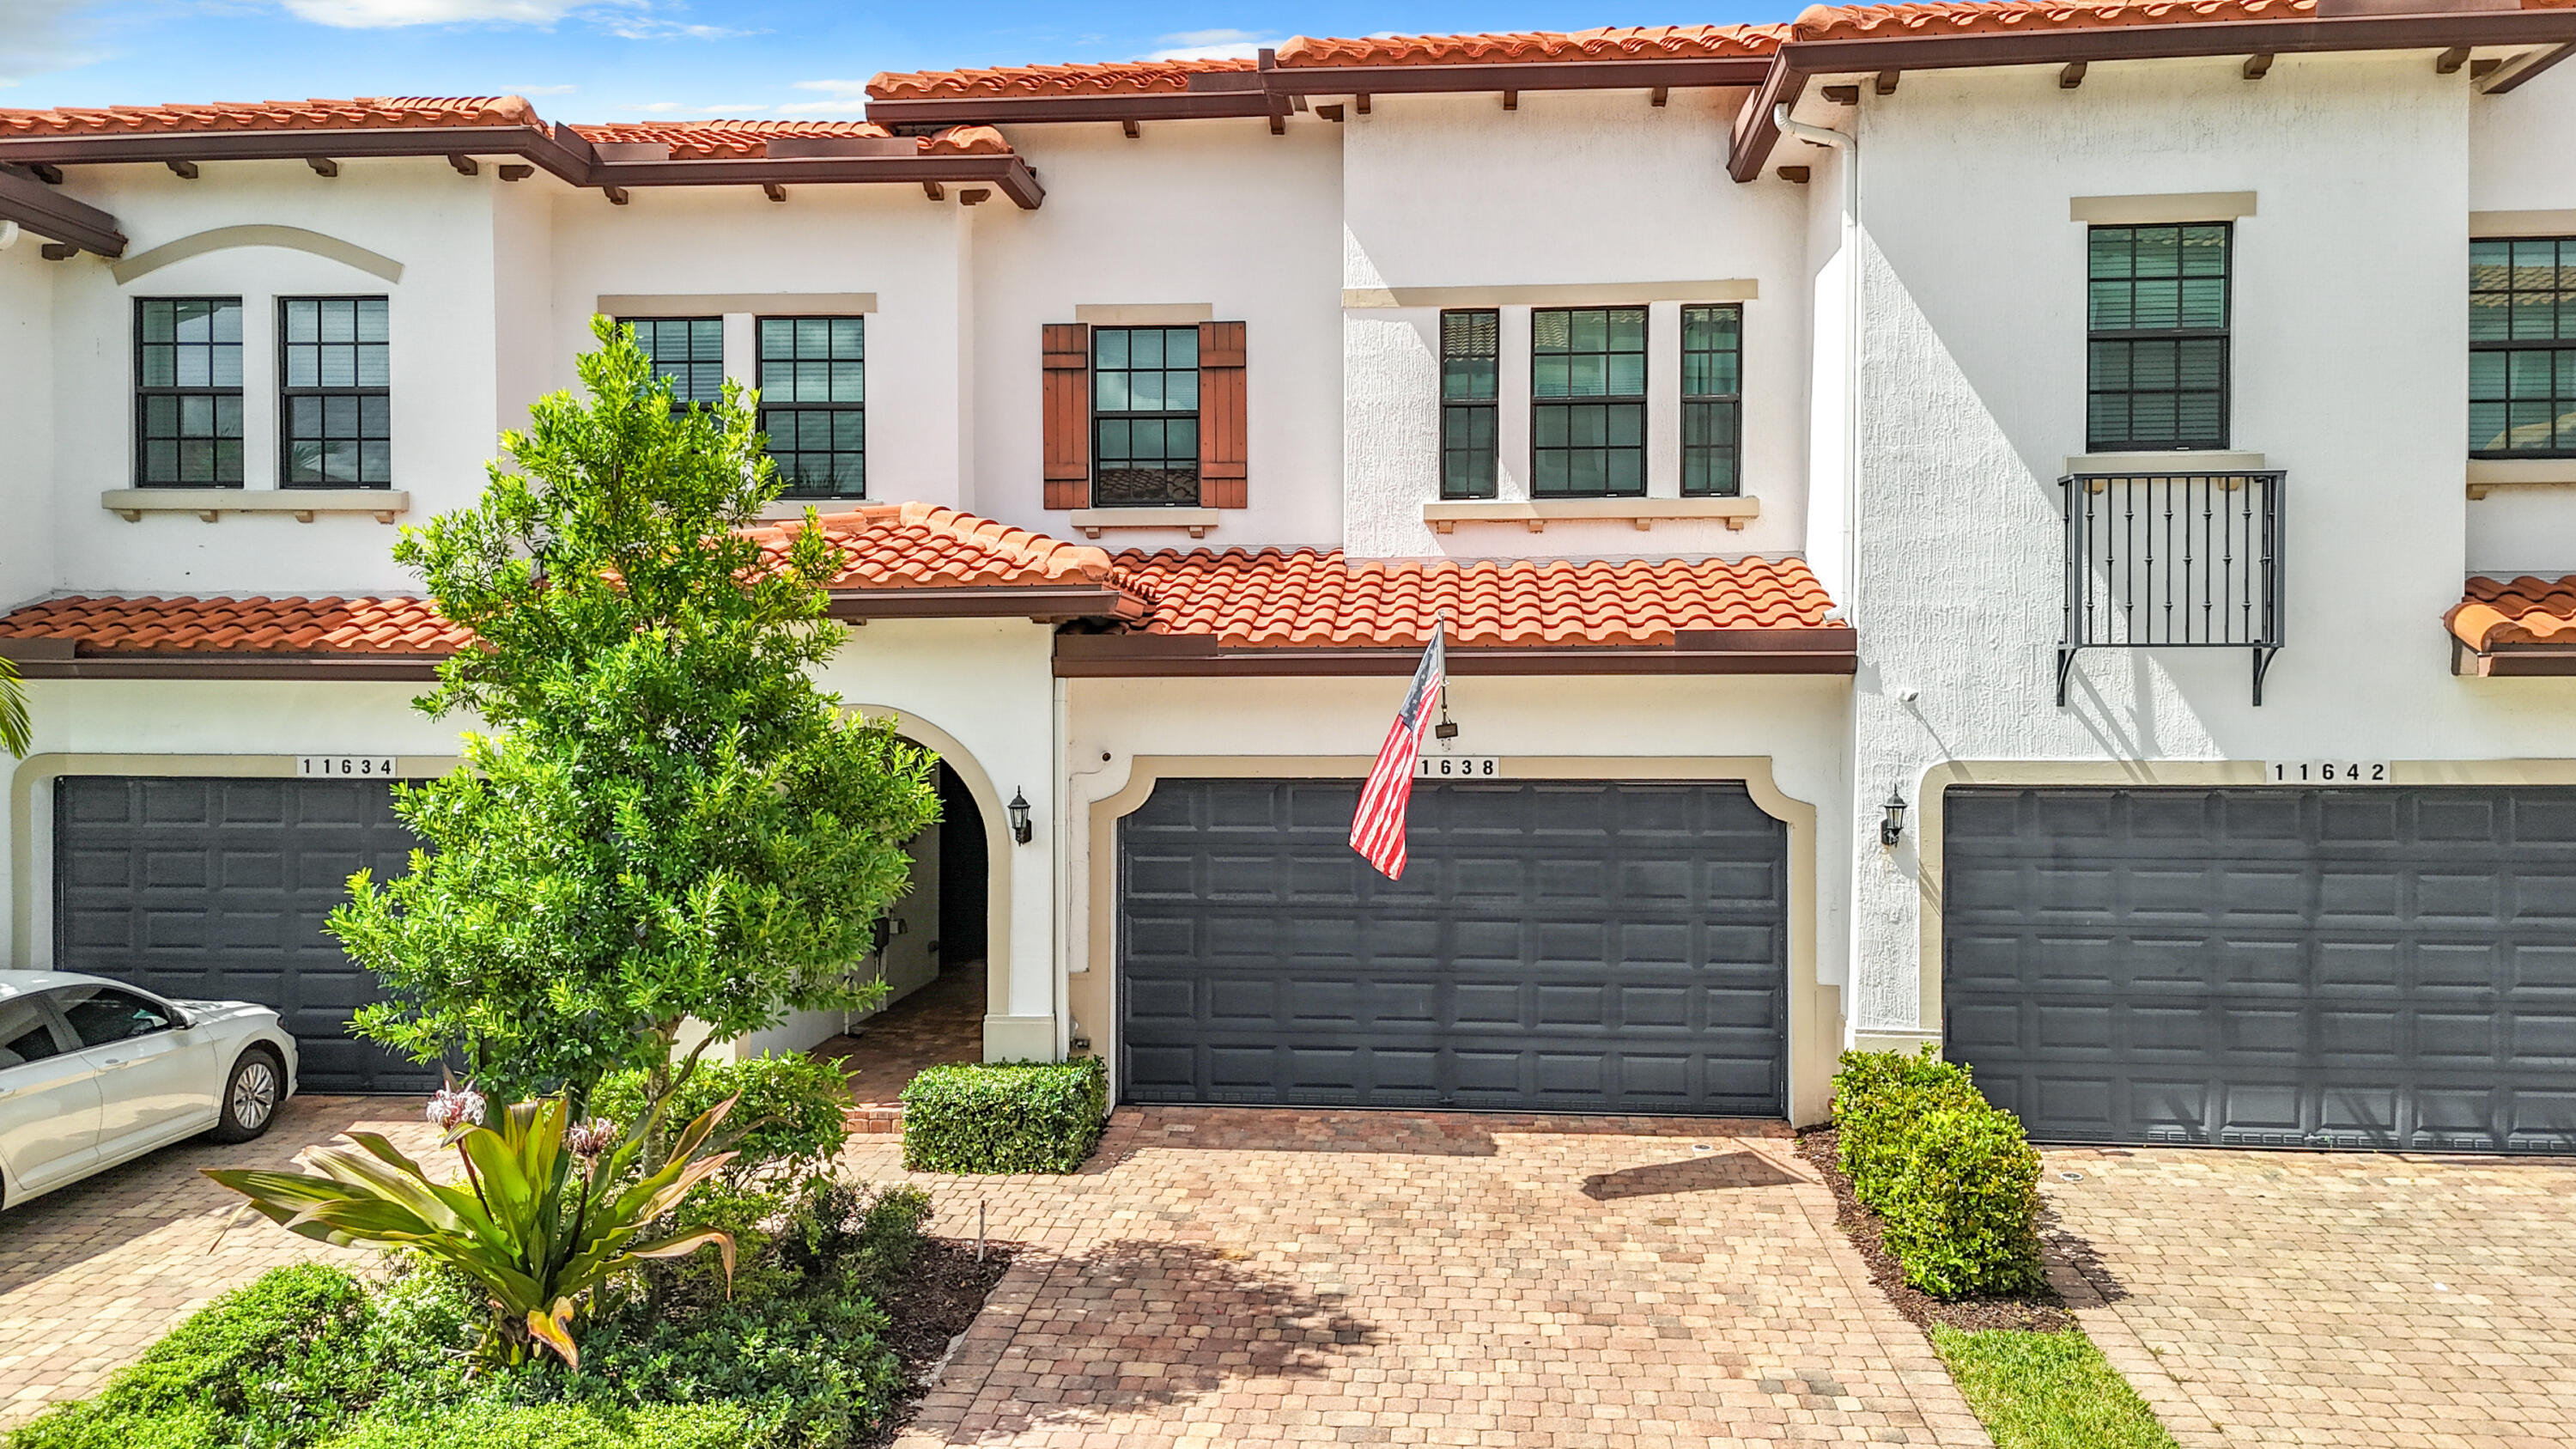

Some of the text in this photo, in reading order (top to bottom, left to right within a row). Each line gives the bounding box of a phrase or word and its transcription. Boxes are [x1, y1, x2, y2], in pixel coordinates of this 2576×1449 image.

[303, 758, 392, 775] 11634
[1420, 759, 1494, 776] 1638
[2275, 763, 2385, 781] 11642
